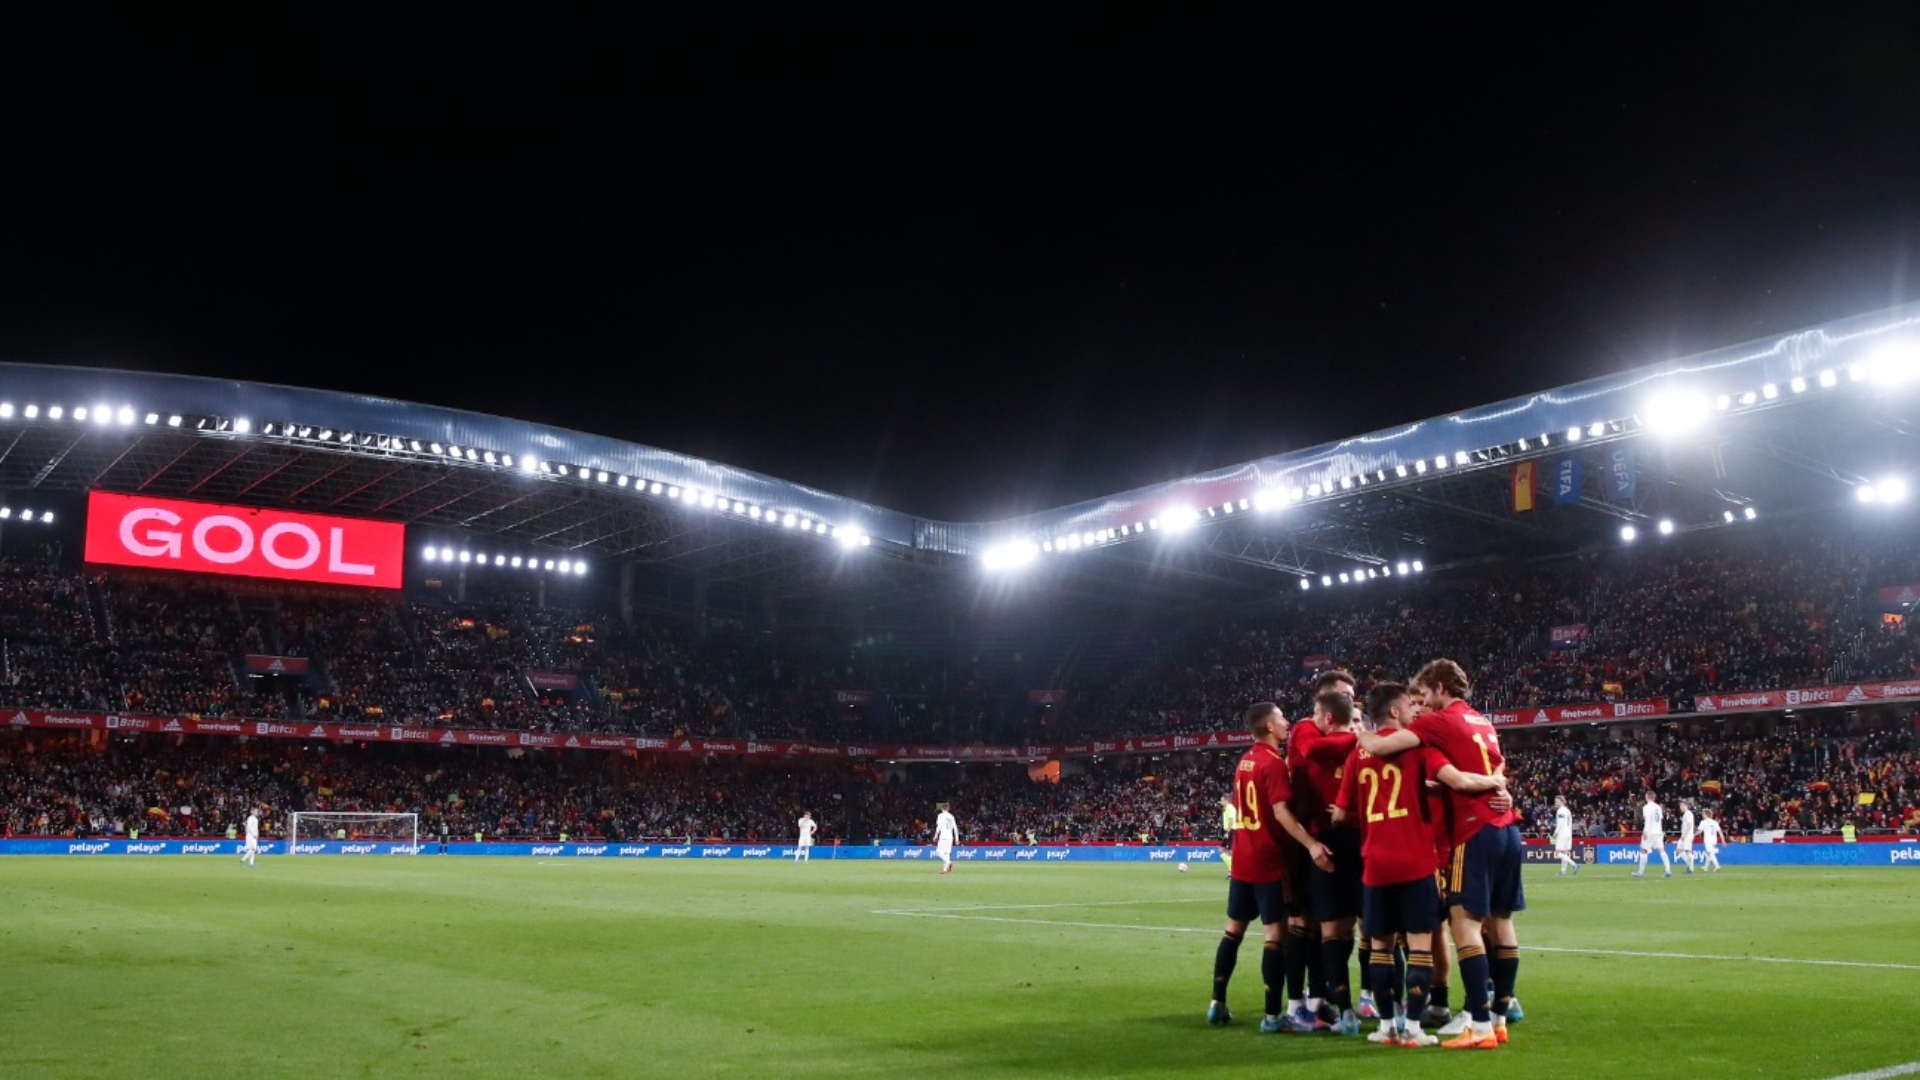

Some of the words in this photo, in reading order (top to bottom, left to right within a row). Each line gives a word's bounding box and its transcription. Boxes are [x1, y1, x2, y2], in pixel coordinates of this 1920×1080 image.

[1559, 460, 1572, 495] FIFA
[1612, 452, 1629, 491] UEFA
[119, 507, 376, 576] GOOL
[1560, 707, 1602, 718] finetwork
[1720, 696, 1768, 707] finetwork
[44, 715, 93, 725] finetwork
[339, 728, 380, 738] finetwork
[1358, 763, 1408, 823] 22
[1232, 779, 1261, 831] 19
[69, 843, 104, 854] pelayo
[127, 843, 161, 854] pelayo
[182, 843, 215, 854] pelayo
[341, 844, 371, 855] pelayo
[532, 846, 560, 856] pelayo
[577, 846, 603, 856] pelayo
[619, 846, 646, 856] pelayo
[661, 847, 688, 857] pelayo
[703, 847, 728, 857] pelayo
[743, 847, 768, 857] pelayo
[1609, 848, 1642, 863] pelay
